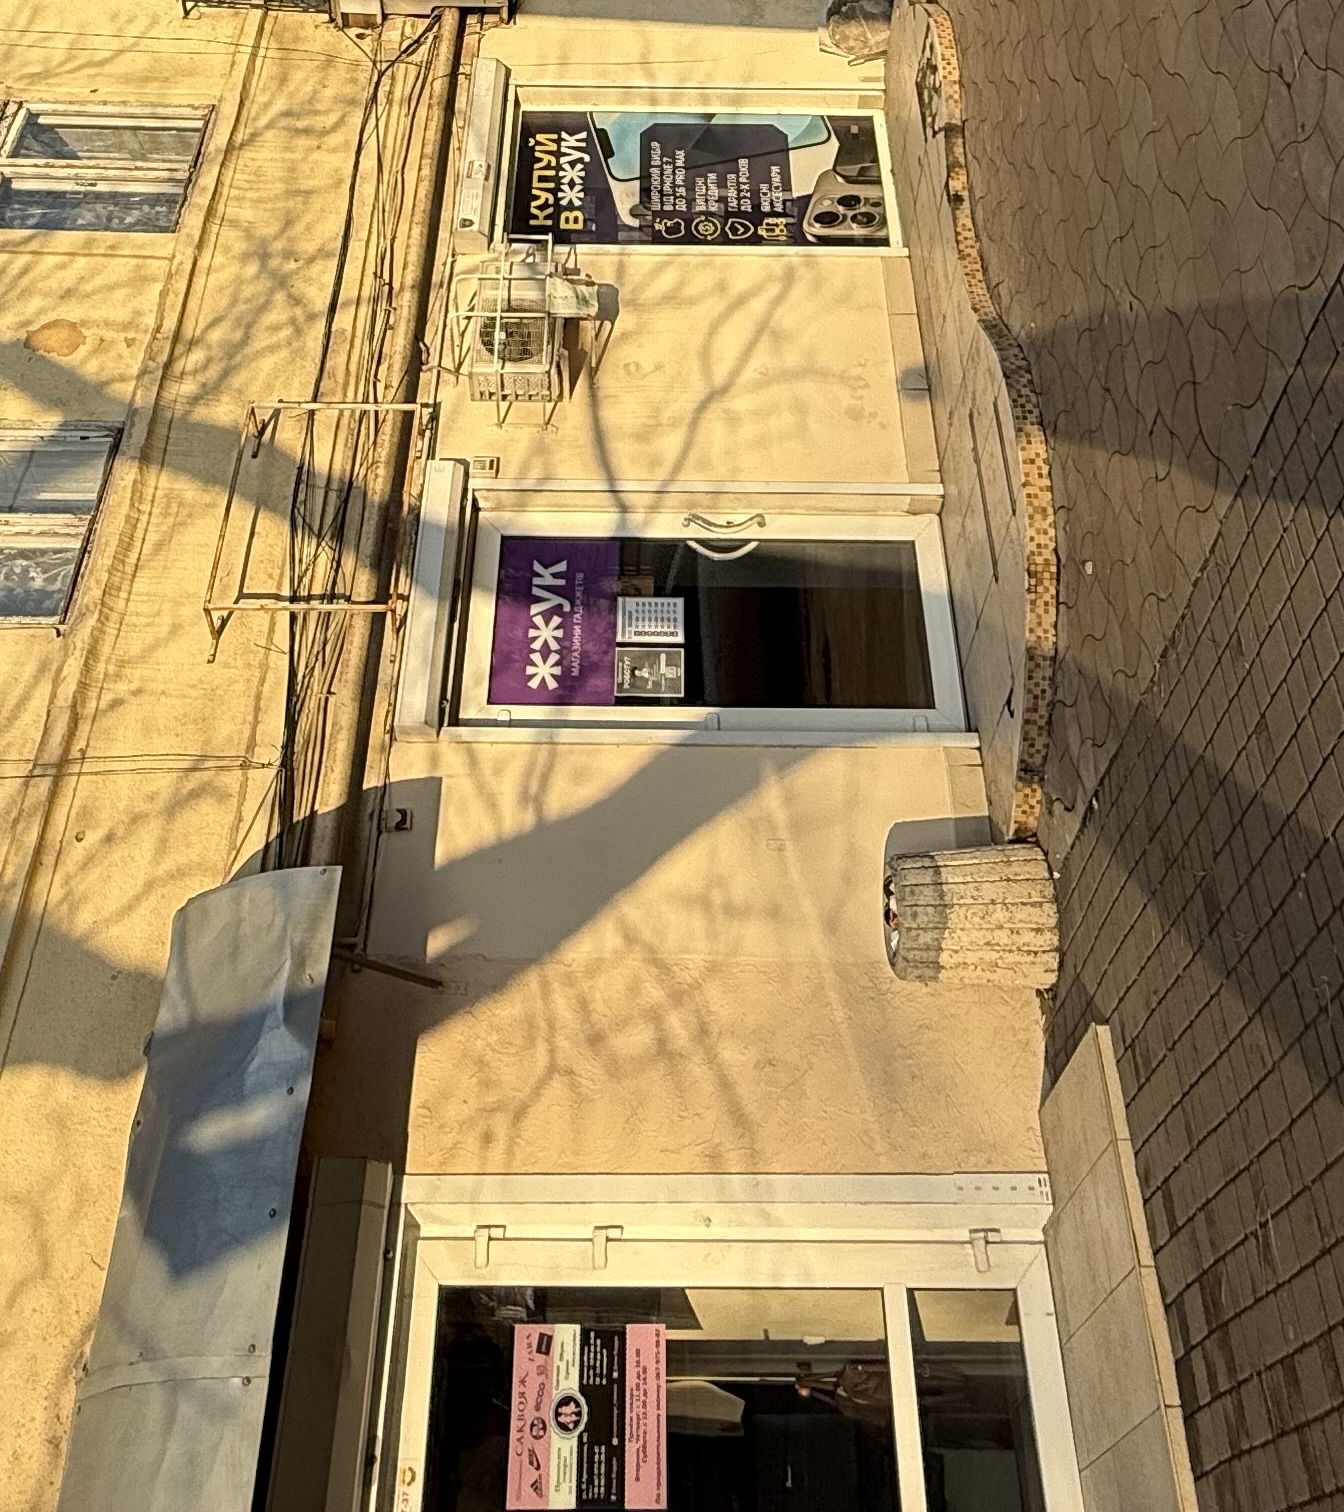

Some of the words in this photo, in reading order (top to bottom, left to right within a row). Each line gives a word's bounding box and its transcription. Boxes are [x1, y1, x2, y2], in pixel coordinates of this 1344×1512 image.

[650, 141, 661, 165] ВИБІР
[675, 150, 685, 166] MAX
[528, 133, 558, 226] КУПУЙ
[663, 163, 674, 194] IPHONE
[675, 168, 686, 185] PRO
[738, 158, 750, 182] РОКІВ
[650, 167, 661, 211] ШИРОКИЙ
[663, 196, 674, 211] ВІД
[695, 177, 706, 211] ВИГІДНІ
[707, 173, 718, 211] КРЕДИТИ
[727, 174, 738, 211] ГАРАНТІЯ
[739, 184, 751, 197] 2-Х
[759, 184, 770, 212] ЯКІСНІ
[770, 166, 784, 212] АКСЕСУАРИ
[675, 198, 687, 211] ДО
[740, 199, 752, 212] ДО
[559, 210, 584, 230] В
[571, 625, 582, 676] МАГАЗИНИ
[534, 1382, 546, 1412] ecco
[515, 1370, 528, 1456] САКВОЯЖ
